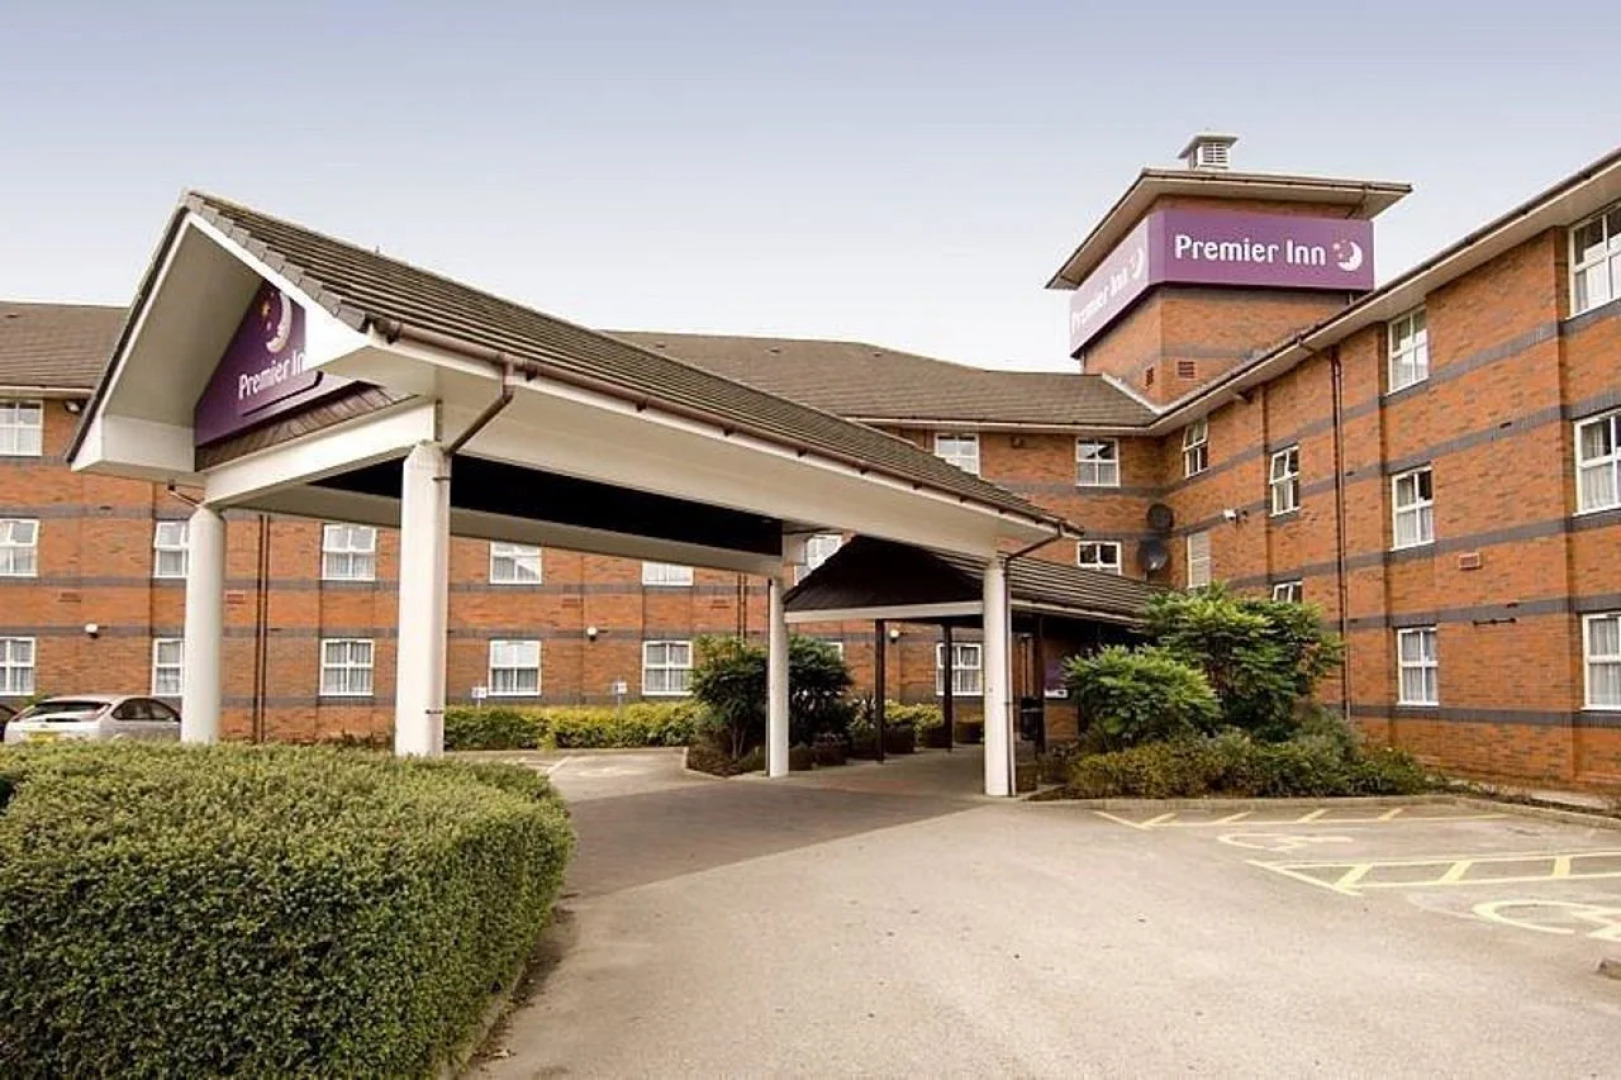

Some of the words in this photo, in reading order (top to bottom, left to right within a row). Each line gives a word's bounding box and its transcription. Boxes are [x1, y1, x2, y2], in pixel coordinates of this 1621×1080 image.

[1175, 234, 1279, 263] Premier
[1286, 239, 1326, 266] Inn
[239, 359, 290, 399] Premier
[291, 350, 305, 377] In
